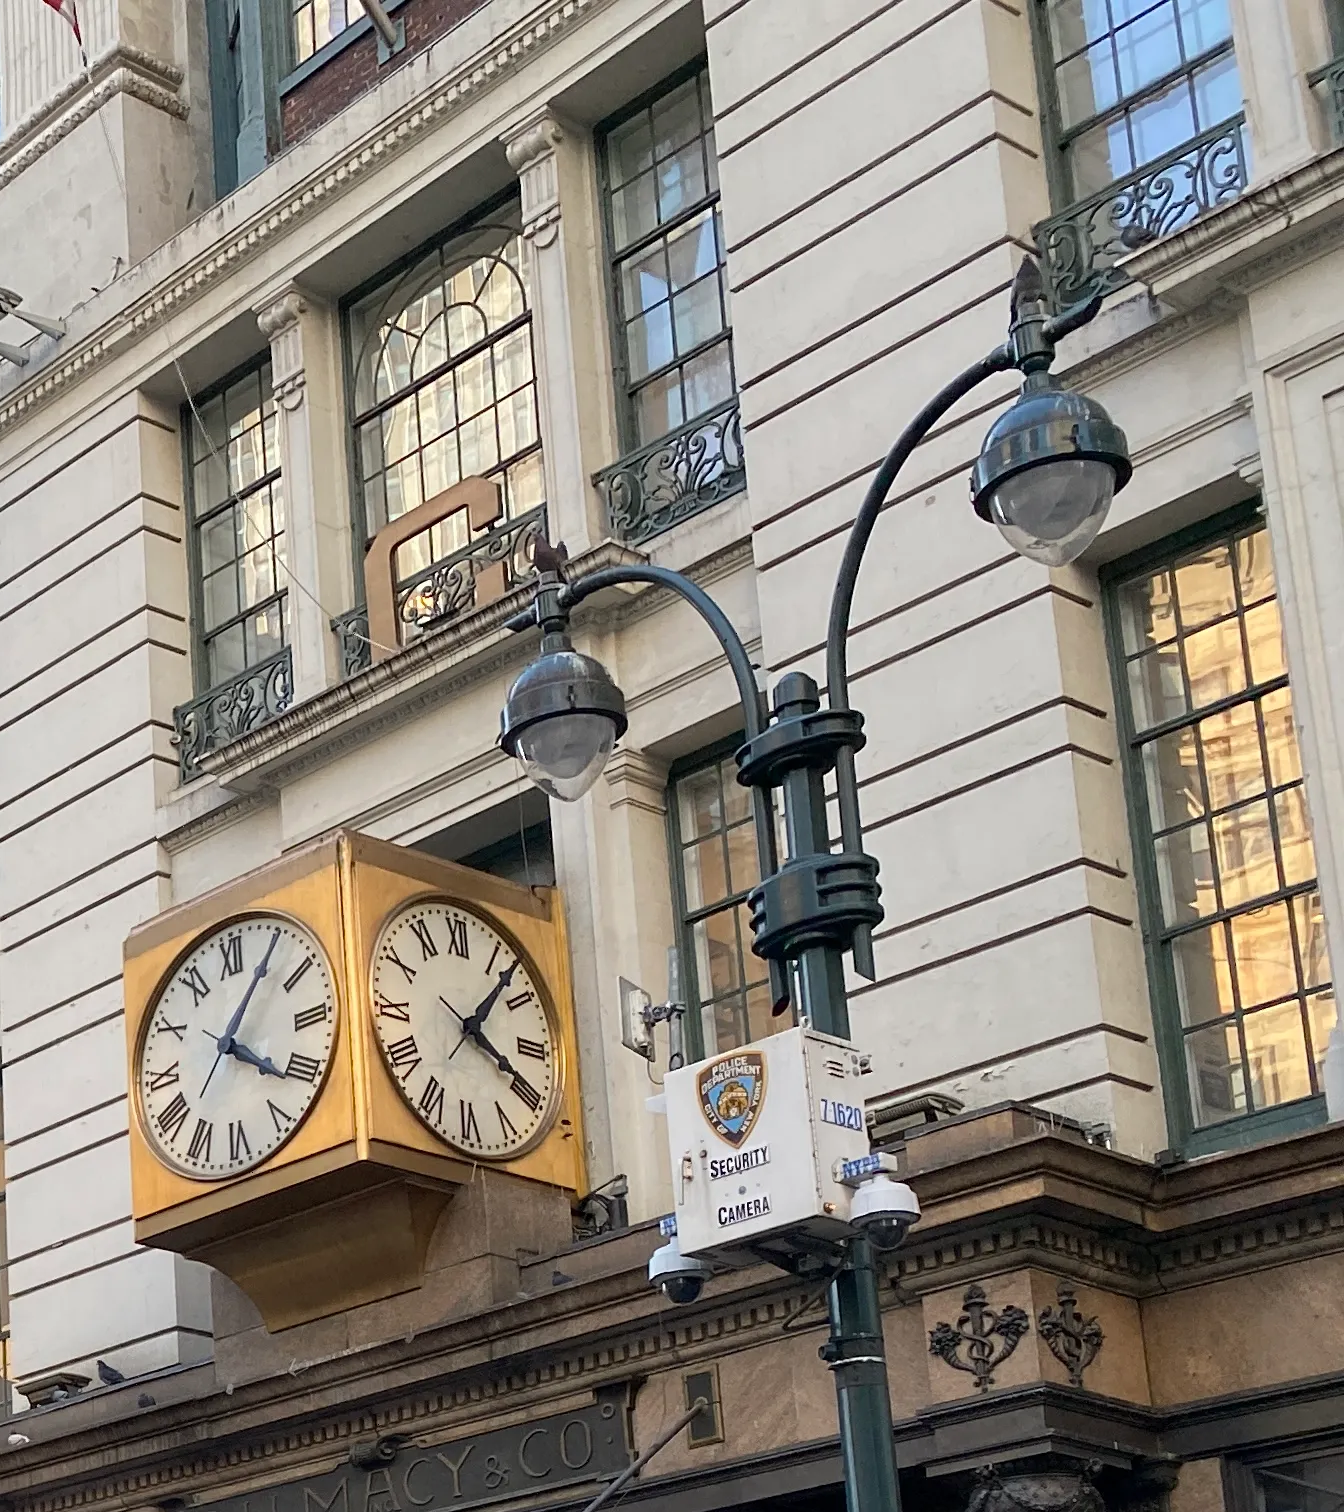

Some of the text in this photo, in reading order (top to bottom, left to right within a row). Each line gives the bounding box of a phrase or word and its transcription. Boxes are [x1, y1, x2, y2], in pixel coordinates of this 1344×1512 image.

[702, 1065, 762, 1096] DEPARTMENT
[712, 1056, 748, 1076] POLICE
[704, 1103, 729, 1135] CITY OF
[739, 1080, 763, 1133] NEW YORK
[711, 1146, 769, 1178] SECURITY
[718, 1197, 770, 1226] CAMERA
